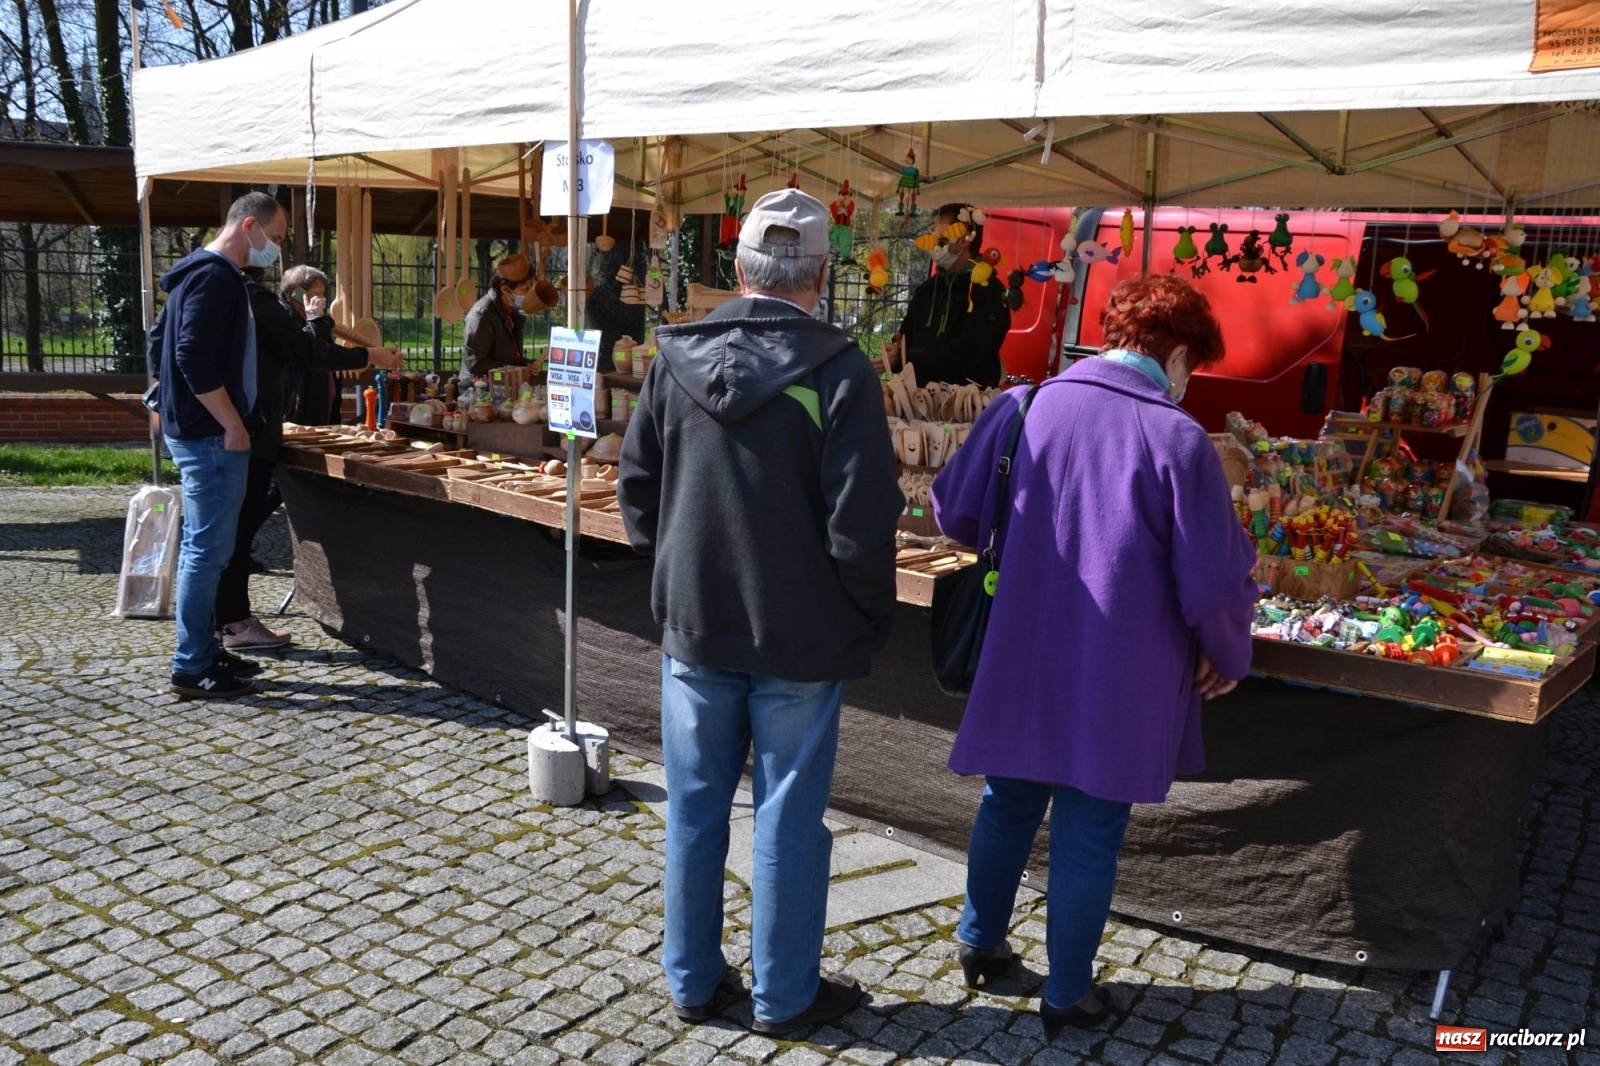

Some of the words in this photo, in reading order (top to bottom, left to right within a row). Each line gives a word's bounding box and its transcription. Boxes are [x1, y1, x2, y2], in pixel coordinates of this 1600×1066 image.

[1543, 27, 1586, 37] PRODUCENT
[1548, 37, 1584, 48] 95-060
[556, 151, 594, 167] Stko
[577, 178, 584, 192] 3
[551, 372, 563, 381] VISA
[567, 373, 580, 382] VISA
